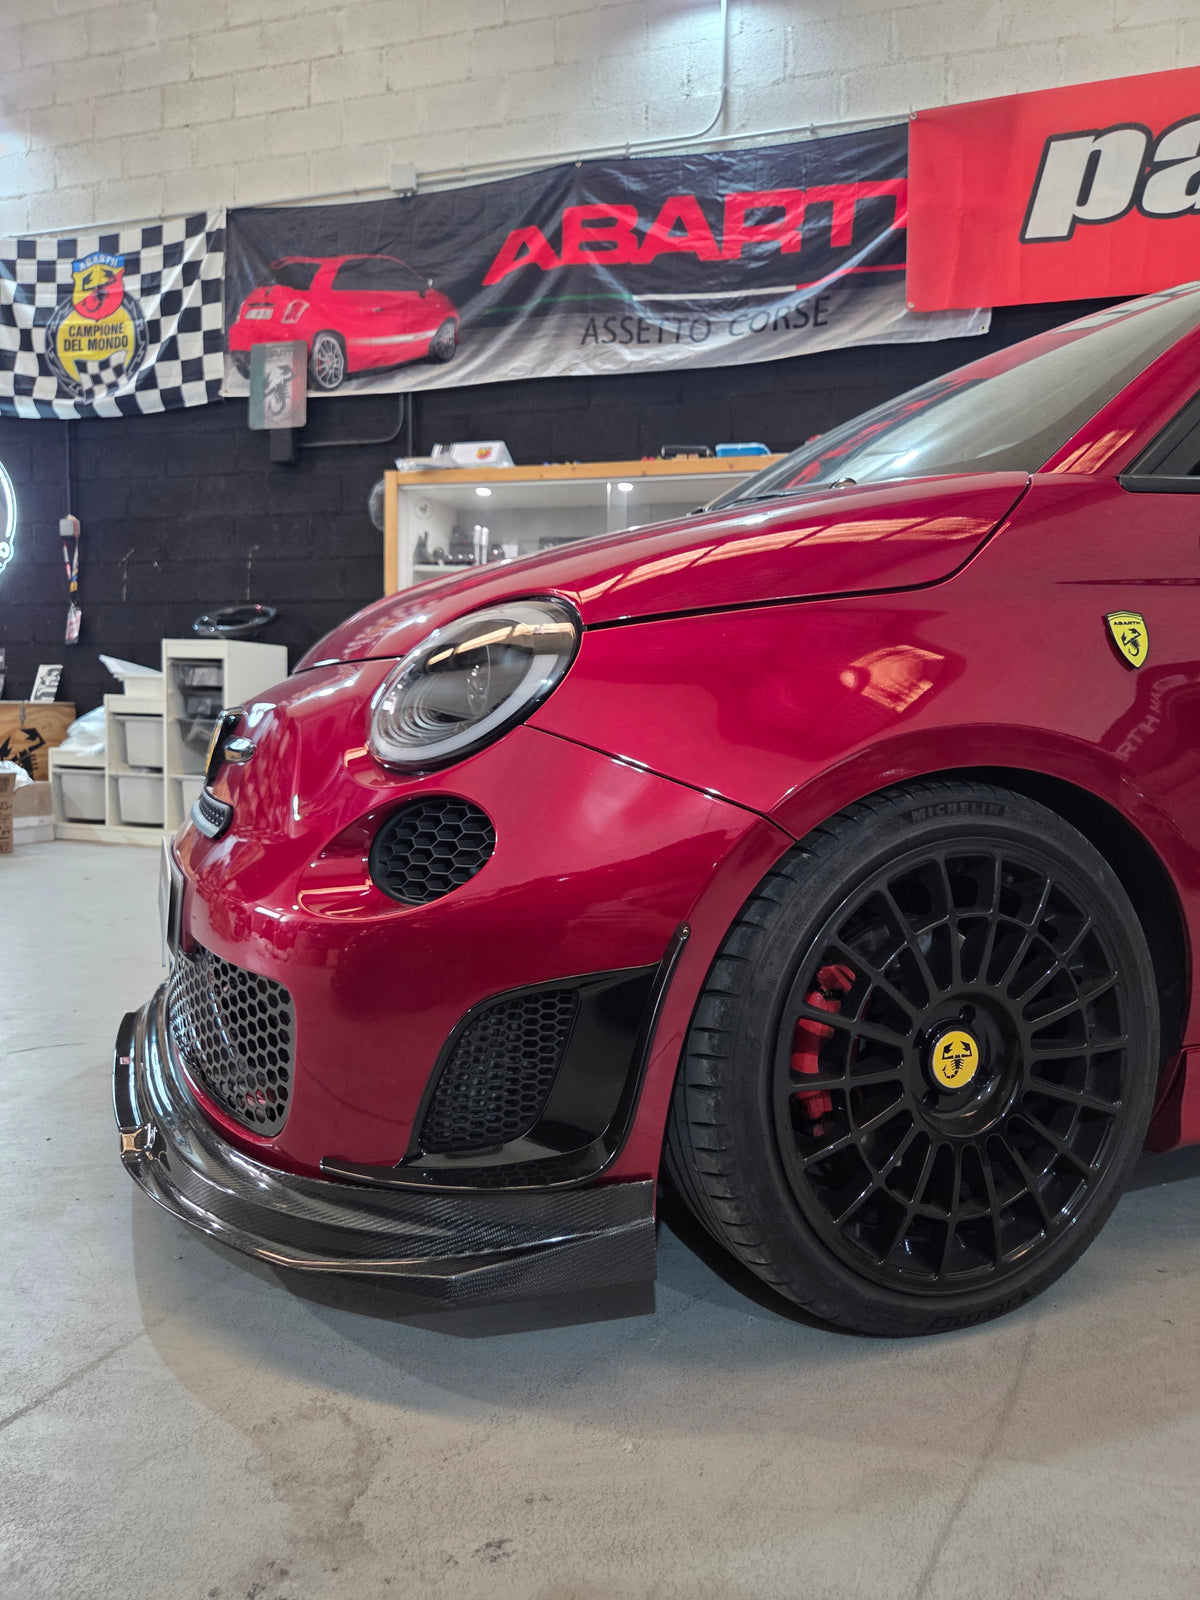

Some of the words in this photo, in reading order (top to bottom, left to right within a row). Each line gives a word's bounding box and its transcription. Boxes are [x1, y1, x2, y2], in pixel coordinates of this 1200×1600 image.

[482, 178, 908, 286] ABART
[79, 254, 118, 269] ABARTH
[68, 322, 124, 337] CAMPIONE
[581, 316, 711, 346] ASSETTO
[728, 296, 830, 337] CORSE
[63, 338, 84, 352] DEL
[88, 335, 128, 351] MONDO
[912, 802, 1000, 822] MICHELIN
